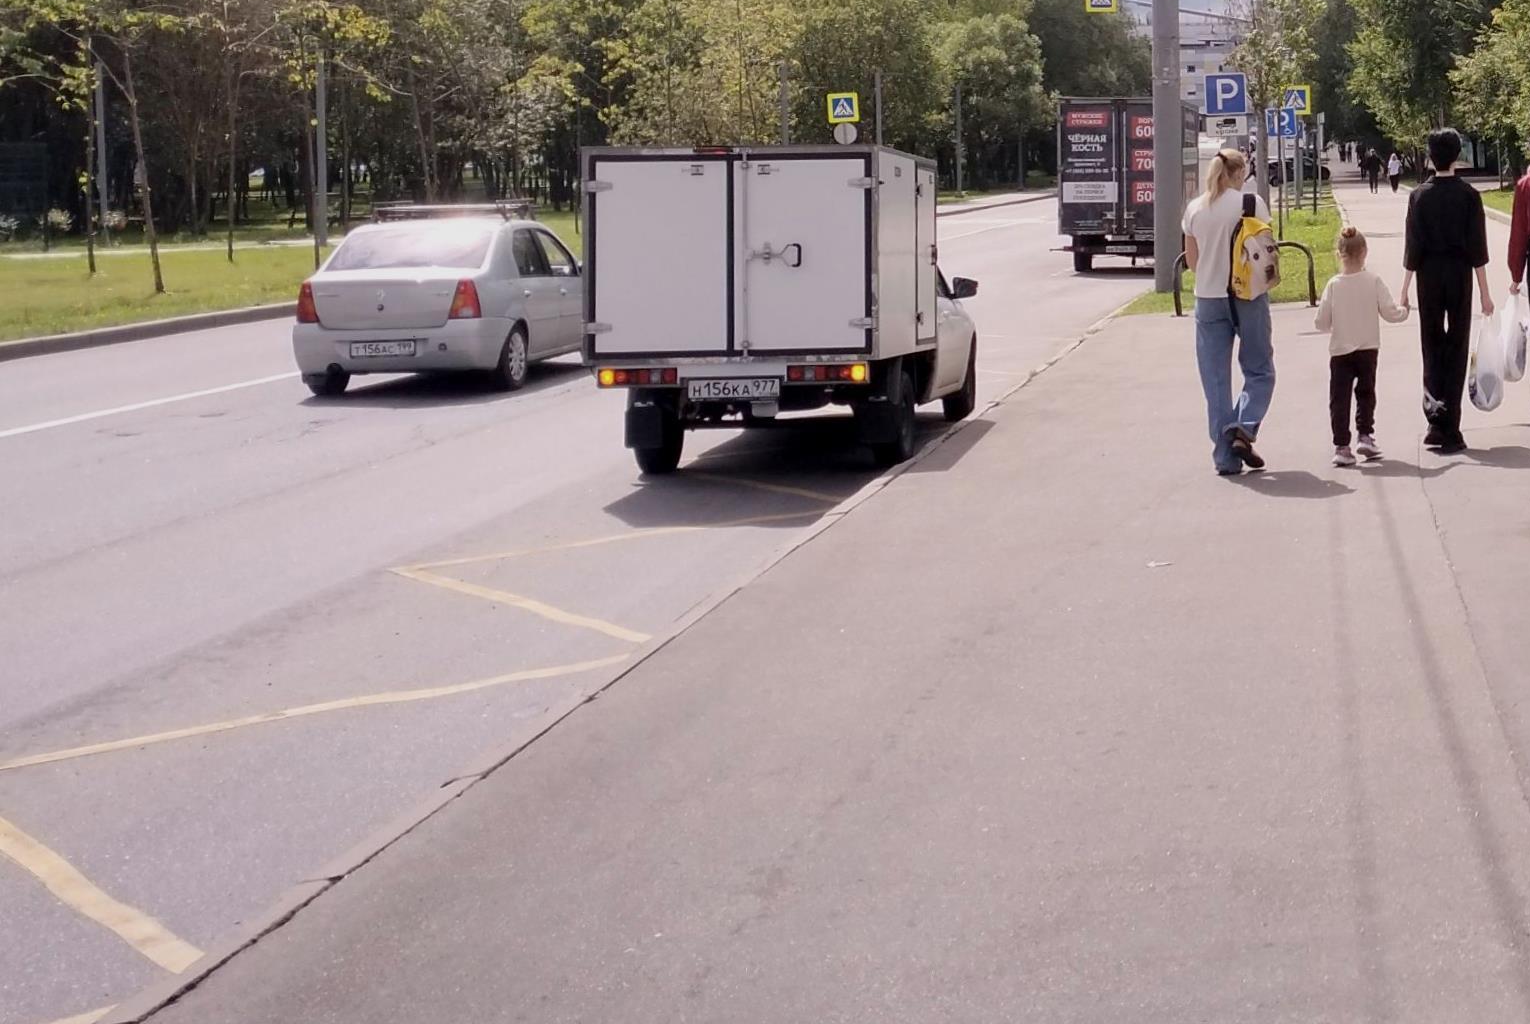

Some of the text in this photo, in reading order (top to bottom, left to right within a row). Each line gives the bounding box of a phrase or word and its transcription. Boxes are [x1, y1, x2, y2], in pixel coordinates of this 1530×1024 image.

[1071, 144, 1103, 152] КОСТЬ
[692, 379, 776, 396] Н156КА 977
